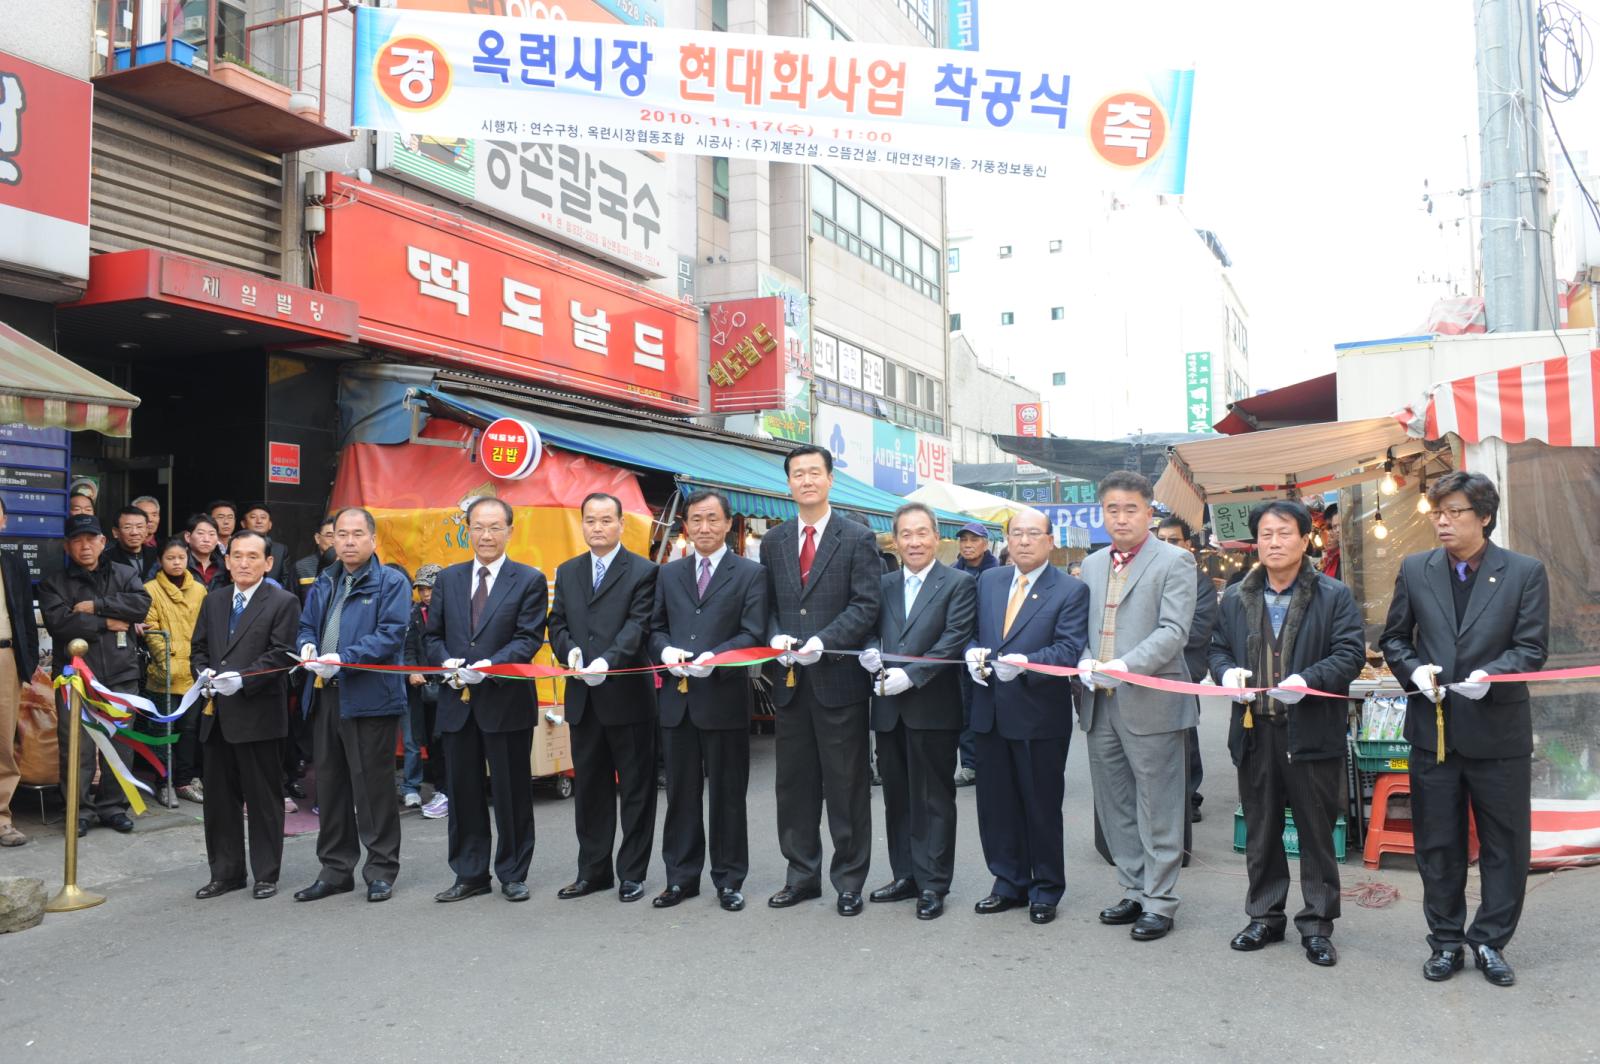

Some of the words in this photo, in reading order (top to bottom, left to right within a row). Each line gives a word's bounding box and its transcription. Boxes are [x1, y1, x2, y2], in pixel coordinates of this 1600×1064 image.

[388, 46, 435, 103] 경
[473, 29, 654, 98] 옥련시장
[679, 42, 907, 117] 현대화사업
[933, 62, 1071, 129] 착공식
[1102, 101, 1153, 159] 축
[639, 108, 700, 125] 2010.
[708, 116, 742, 130] 11.
[749, 119, 816, 136] 17(수)
[831, 127, 893, 144] 11:00
[586, 126, 686, 147] 옥련시장협동조합
[970, 158, 1048, 180] 거풍정보통신
[202, 275, 324, 322] 제일빌딩
[406, 245, 665, 372] 떡도날드
[813, 336, 835, 374] 현대
[863, 356, 883, 391] 학원
[491, 446, 519, 464] 김밥
[874, 438, 915, 484] 새마을금고
[917, 438, 946, 482] 신발
[1063, 485, 1095, 504] 계란
